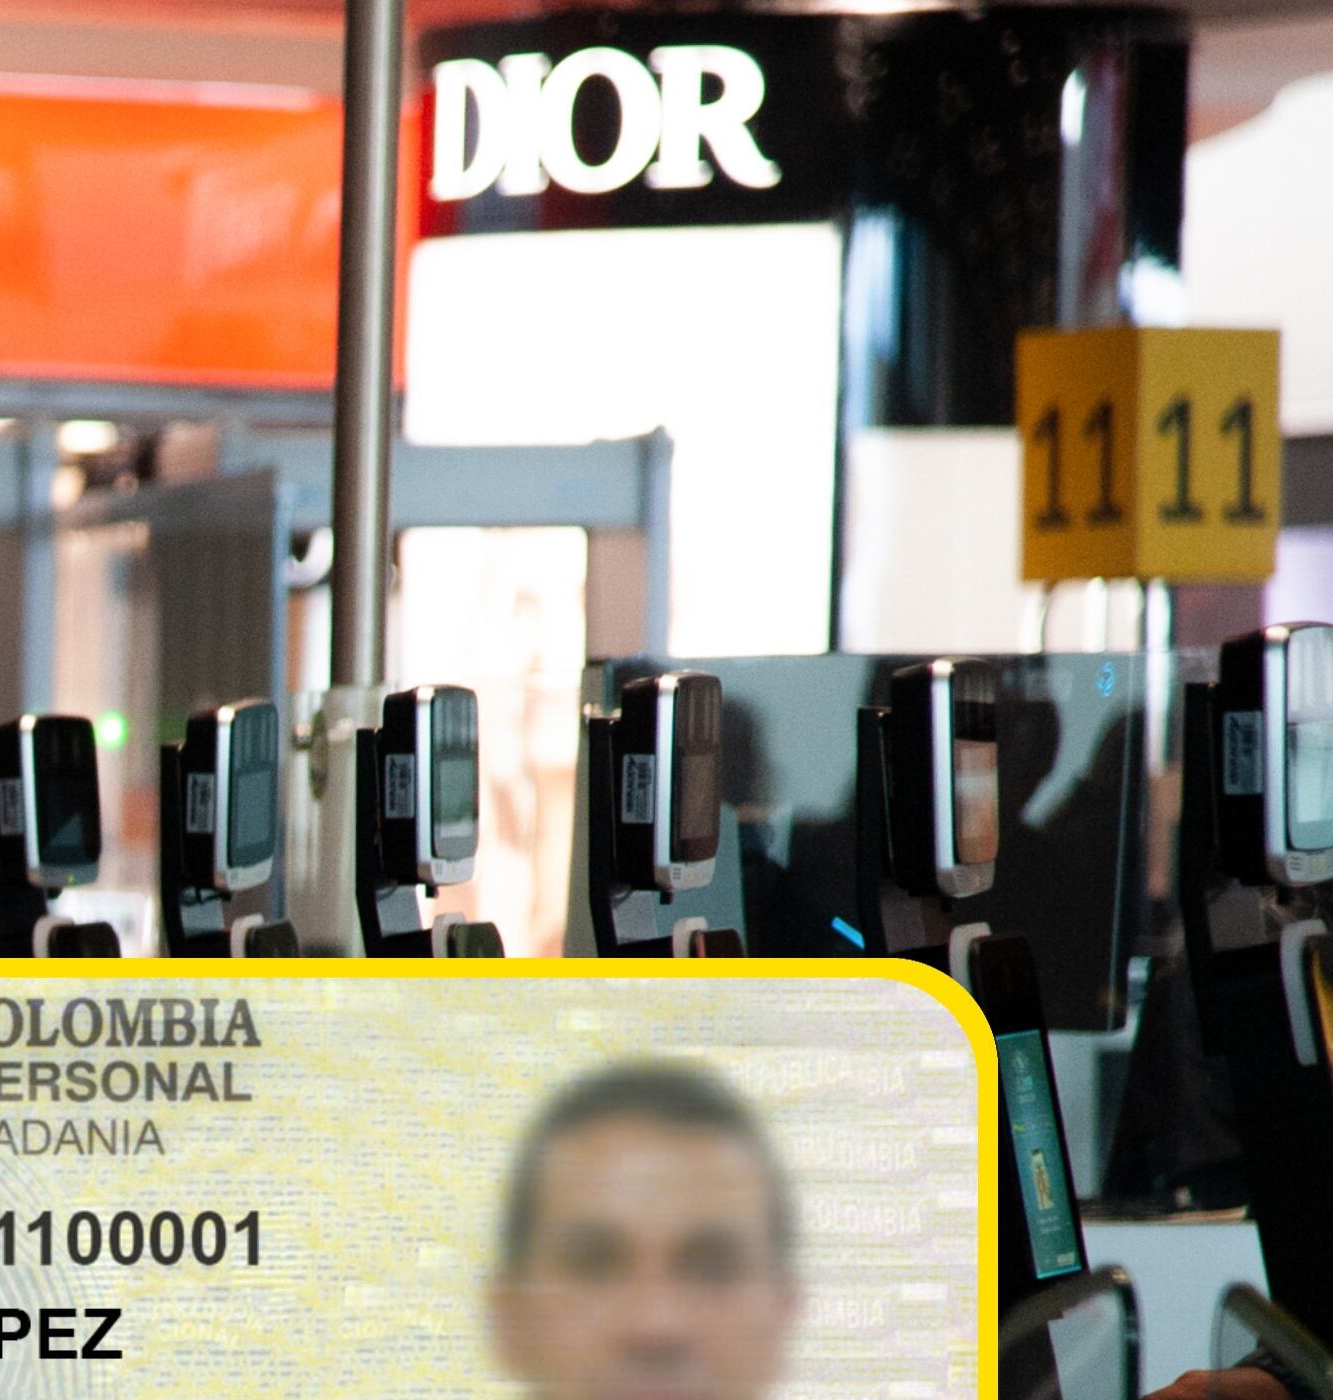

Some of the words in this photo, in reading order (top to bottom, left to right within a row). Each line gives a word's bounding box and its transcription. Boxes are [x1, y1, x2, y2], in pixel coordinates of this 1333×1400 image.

[429, 44, 782, 202] DIOR
[1035, 402, 1124, 532] 11
[1158, 397, 1267, 525] 11
